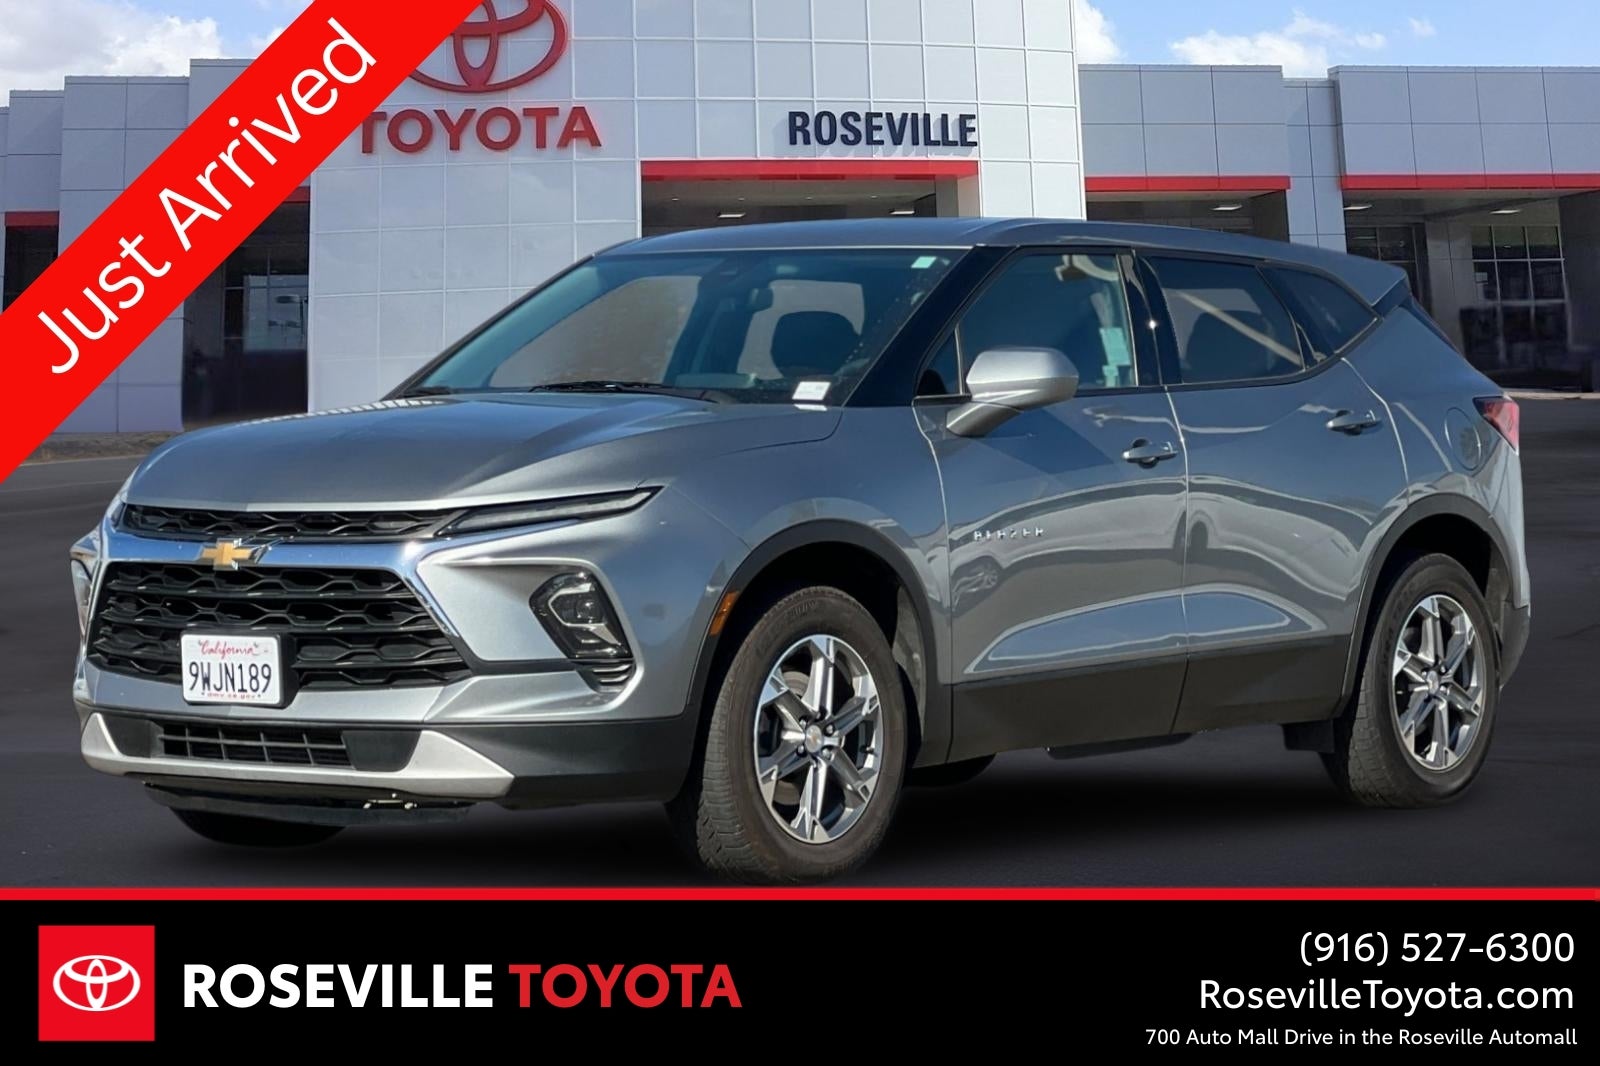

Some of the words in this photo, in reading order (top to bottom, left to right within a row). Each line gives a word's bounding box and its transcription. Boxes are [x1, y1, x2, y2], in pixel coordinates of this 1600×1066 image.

[361, 106, 602, 154] TOYOTA
[788, 110, 978, 147] ROSEVILLE
[973, 526, 1044, 541] BLAZER
[199, 639, 257, 659] California
[189, 661, 272, 694] 9WJN189
